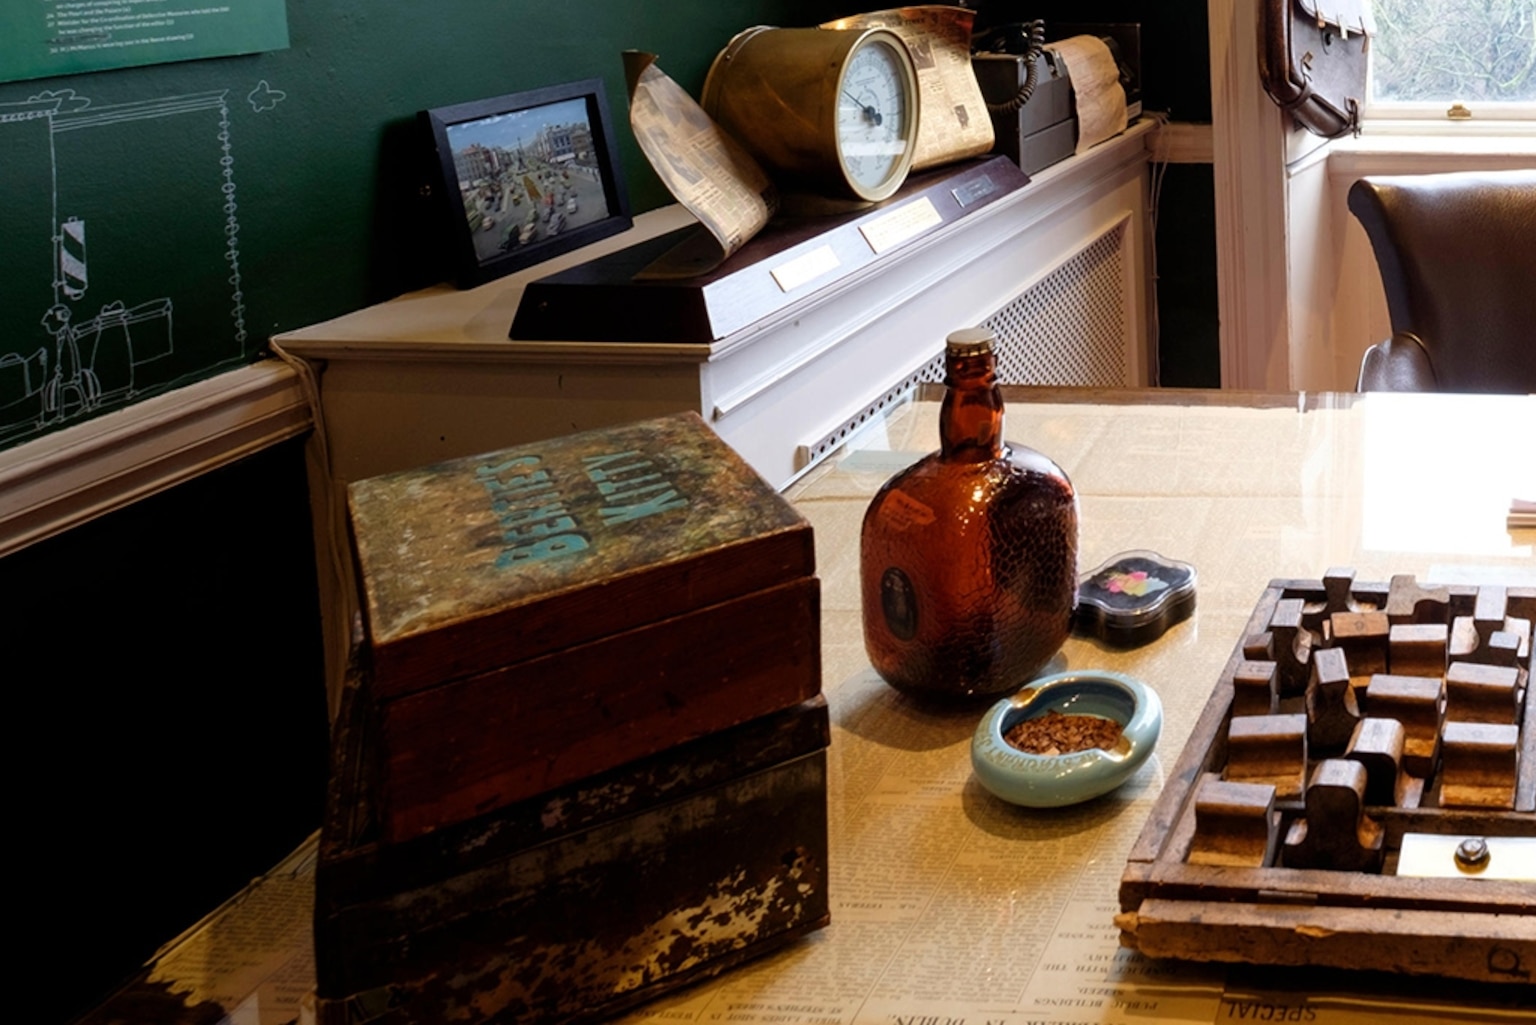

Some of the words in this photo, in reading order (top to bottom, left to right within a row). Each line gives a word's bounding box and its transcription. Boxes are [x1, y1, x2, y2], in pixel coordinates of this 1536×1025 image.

[580, 449, 690, 527] KITTY
[1034, 997, 1104, 1008] BUILDINGS
[1111, 999, 1158, 1011] PUBLIC
[1226, 1002, 1316, 1022] SPECIAL
